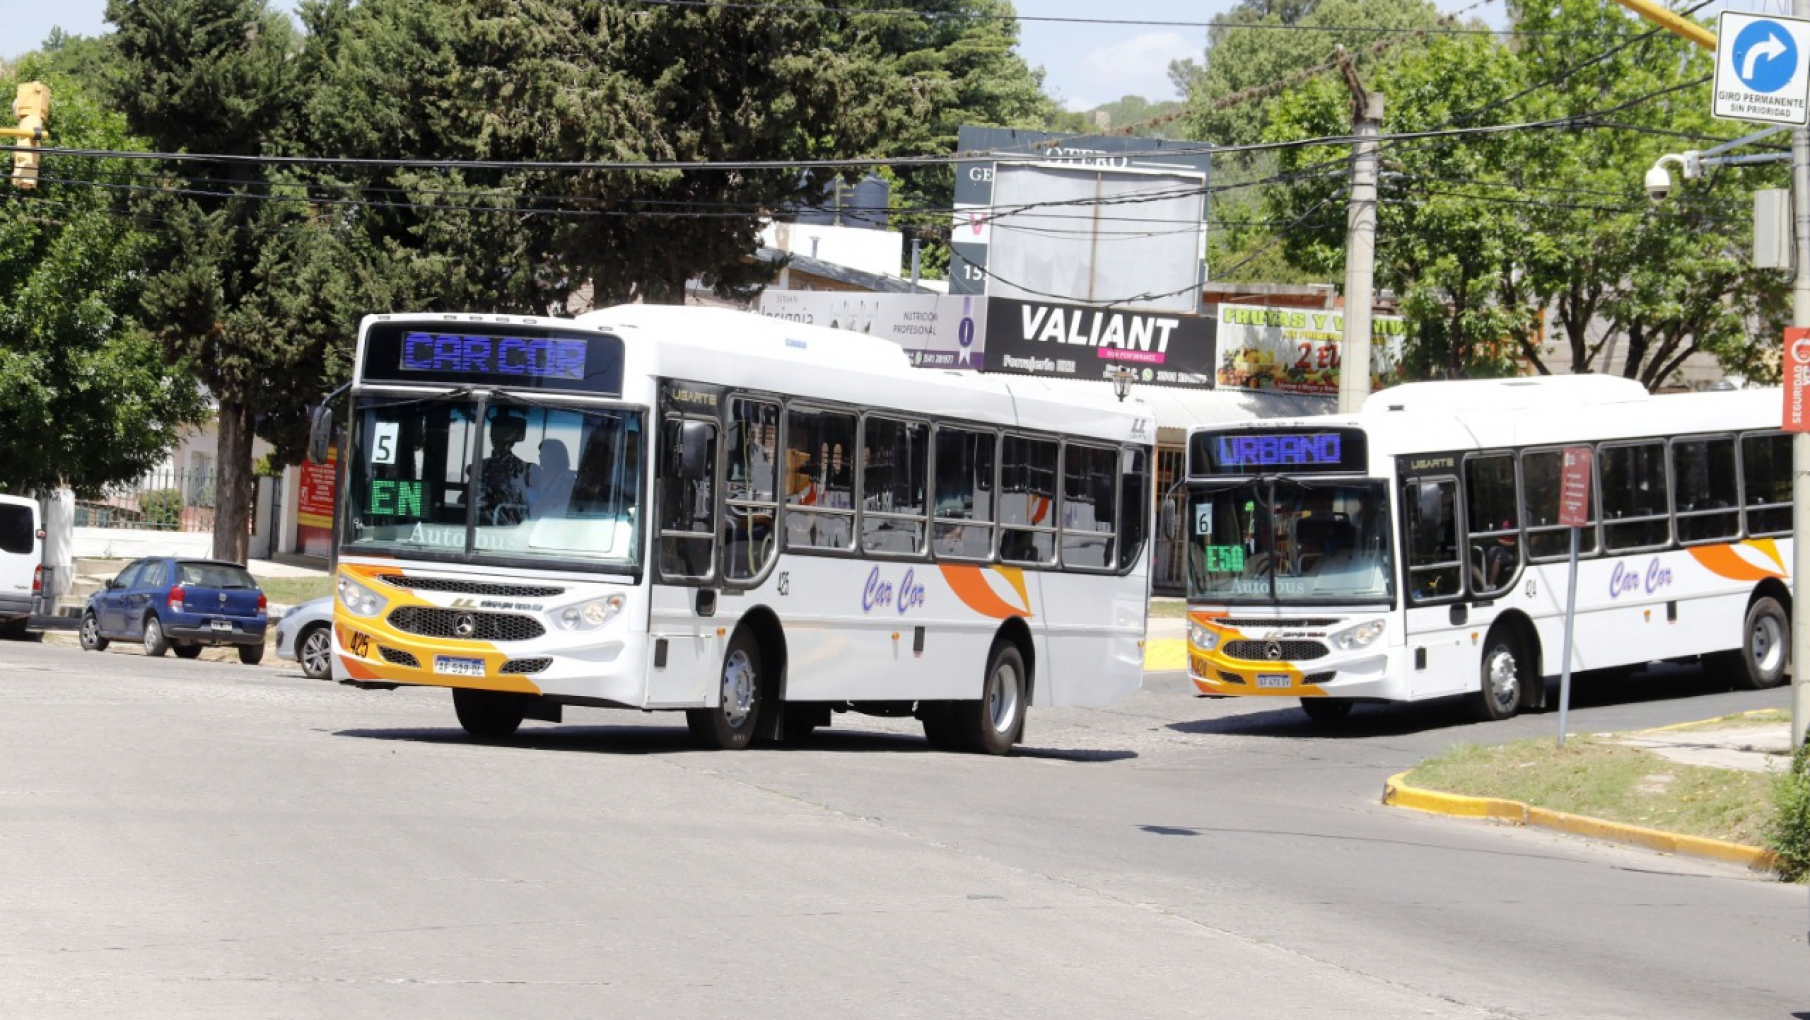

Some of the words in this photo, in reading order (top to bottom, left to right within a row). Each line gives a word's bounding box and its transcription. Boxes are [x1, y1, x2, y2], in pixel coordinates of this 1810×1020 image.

[1718, 91, 1740, 101] GIRO
[1743, 93, 1805, 108] PERMANENTE
[1731, 103, 1744, 112] SIN
[1747, 105, 1791, 117] PRIORIDAD
[893, 324, 937, 335] PROFESIONAL
[1022, 304, 1179, 353] VALIANT
[1223, 308, 1306, 328] FRUTAS
[1312, 314, 1327, 330] Y
[405, 333, 491, 372] CAR
[499, 337, 587, 380] COR
[1792, 364, 1803, 424] SEGURIDAD
[375, 435, 392, 461] 5
[1219, 434, 1341, 465] URBANO
[1411, 457, 1454, 469] UGARTE
[371, 480, 423, 517] EN
[1199, 513, 1209, 533] 6
[862, 564, 893, 613] Car
[898, 566, 926, 615] Cor
[1609, 560, 1640, 598] Car
[1645, 556, 1673, 594] Cor
[350, 631, 370, 658] 425
